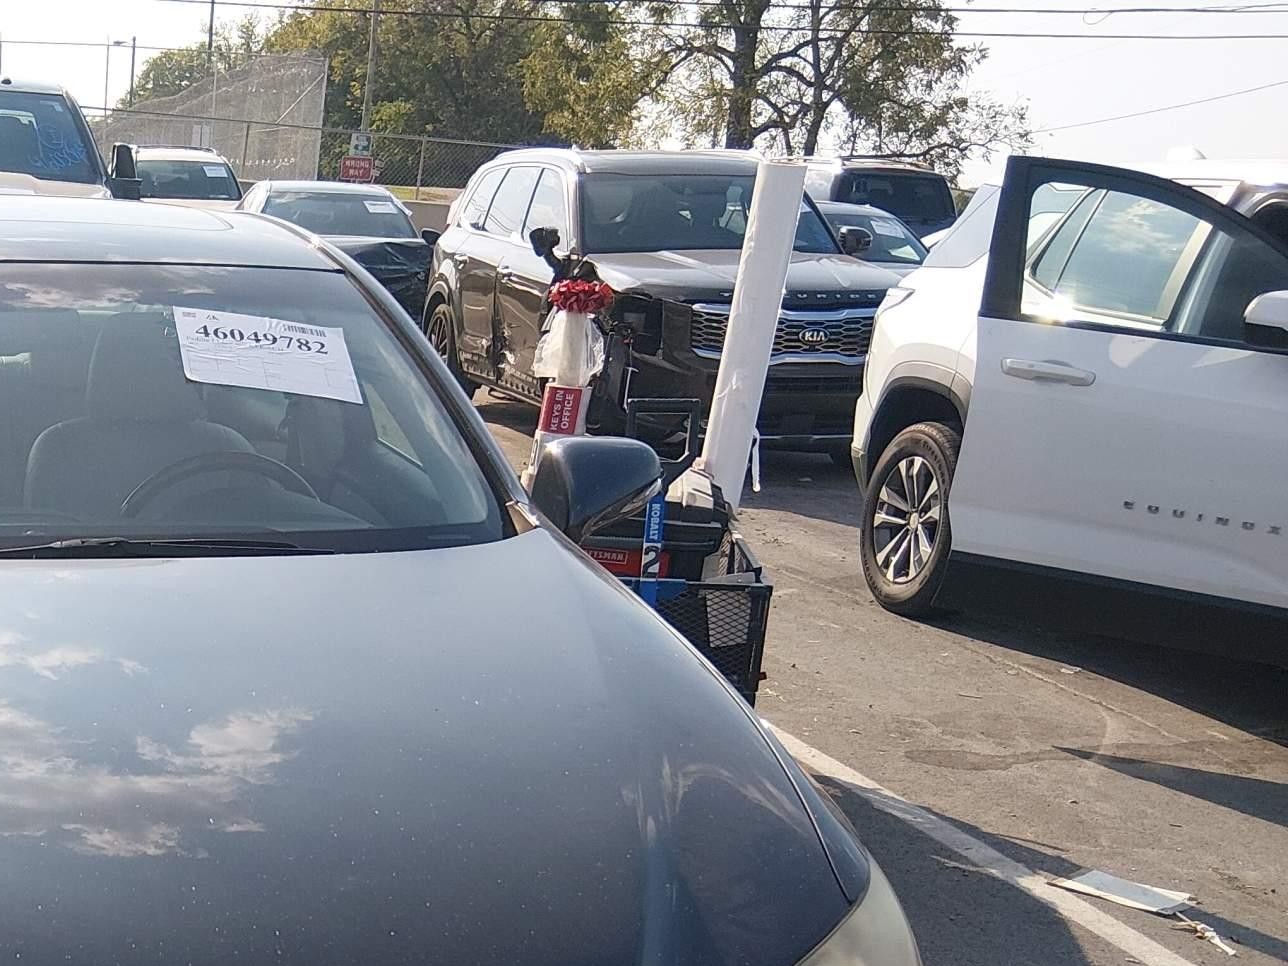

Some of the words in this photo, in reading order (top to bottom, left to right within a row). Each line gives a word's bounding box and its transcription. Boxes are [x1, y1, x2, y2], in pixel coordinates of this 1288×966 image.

[345, 160, 369, 168] WRONG
[195, 324, 328, 355] 46049782
[804, 331, 825, 342] KIA
[555, 390, 565, 401] IN
[560, 393, 575, 429] OFFICE
[550, 403, 562, 430] KEYS
[649, 503, 661, 540] KOBALT
[1123, 500, 1282, 535] EQUINOX
[642, 545, 660, 578] 2
